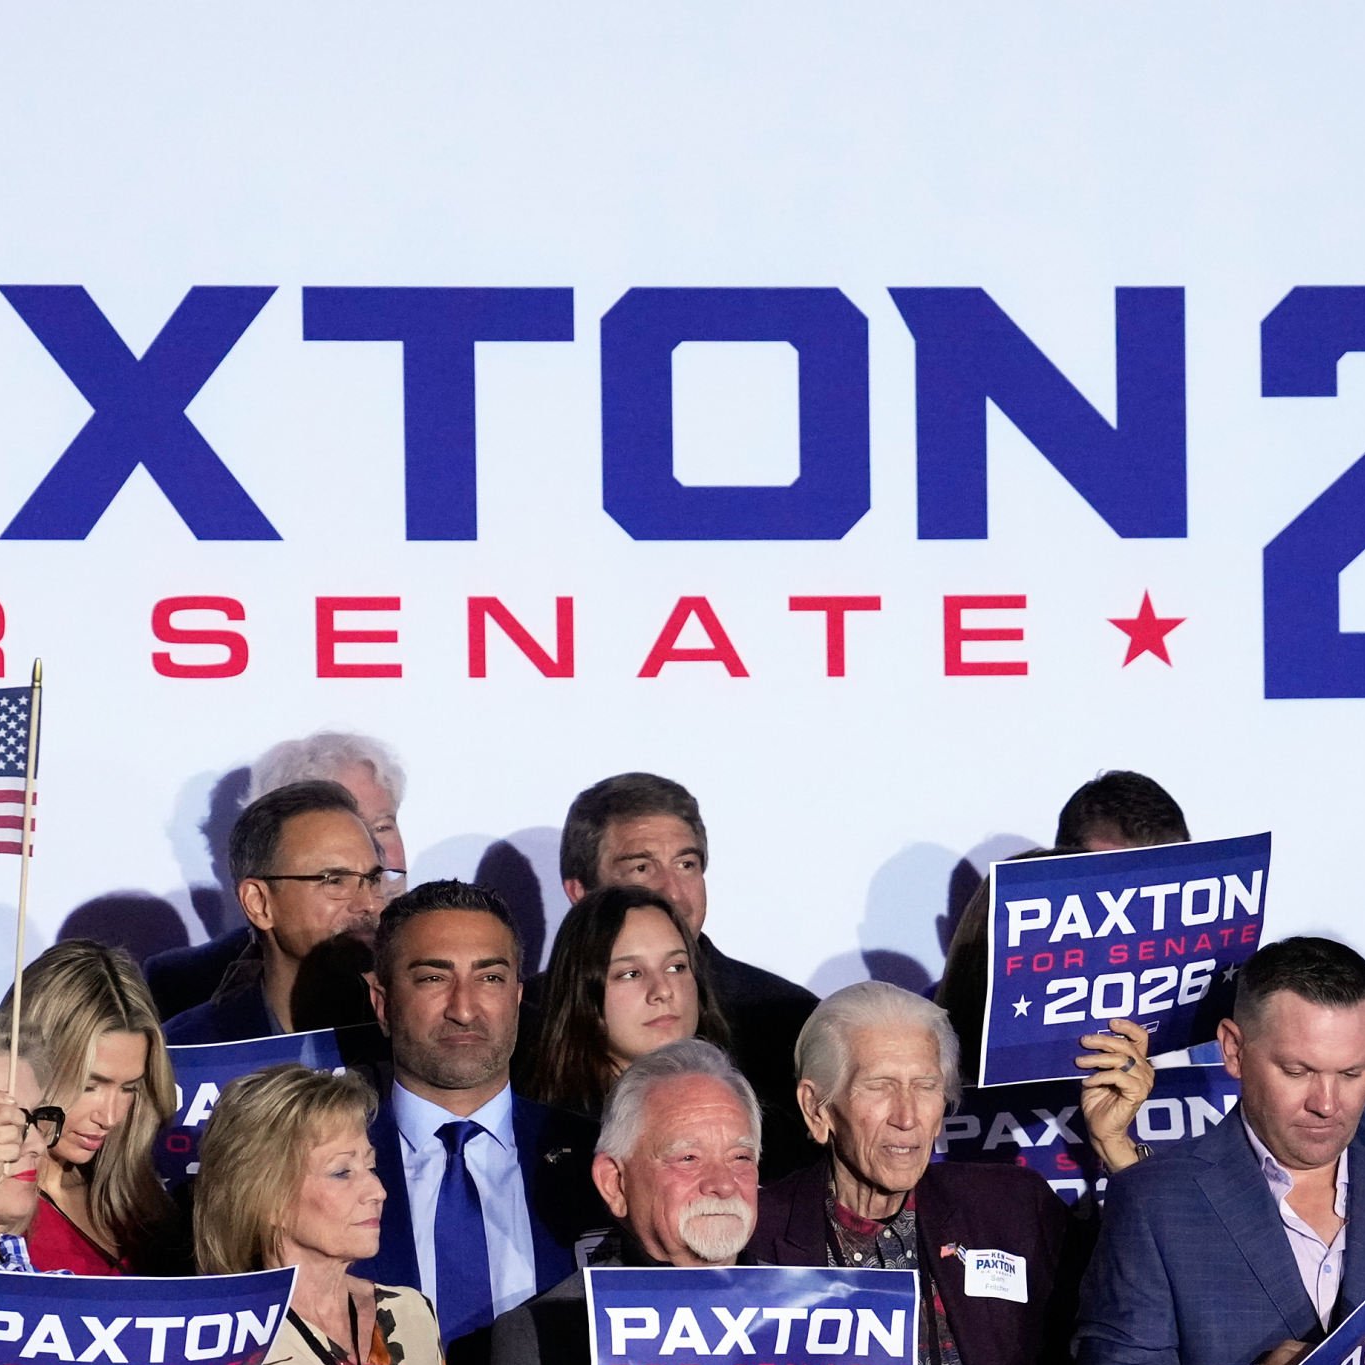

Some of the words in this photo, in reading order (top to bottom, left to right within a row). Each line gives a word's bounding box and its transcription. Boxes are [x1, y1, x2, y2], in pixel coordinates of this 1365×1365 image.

[150, 594, 1029, 679] SENATE
[1005, 869, 1263, 947] PAXTON
[1006, 949, 1084, 976] FOR
[1108, 924, 1258, 964] SENATE
[1043, 958, 1217, 1025] 2026
[934, 1095, 1238, 1154] PAXON
[976, 1259, 1016, 1275] PAXTON
[604, 1306, 906, 1357] PAXTON
